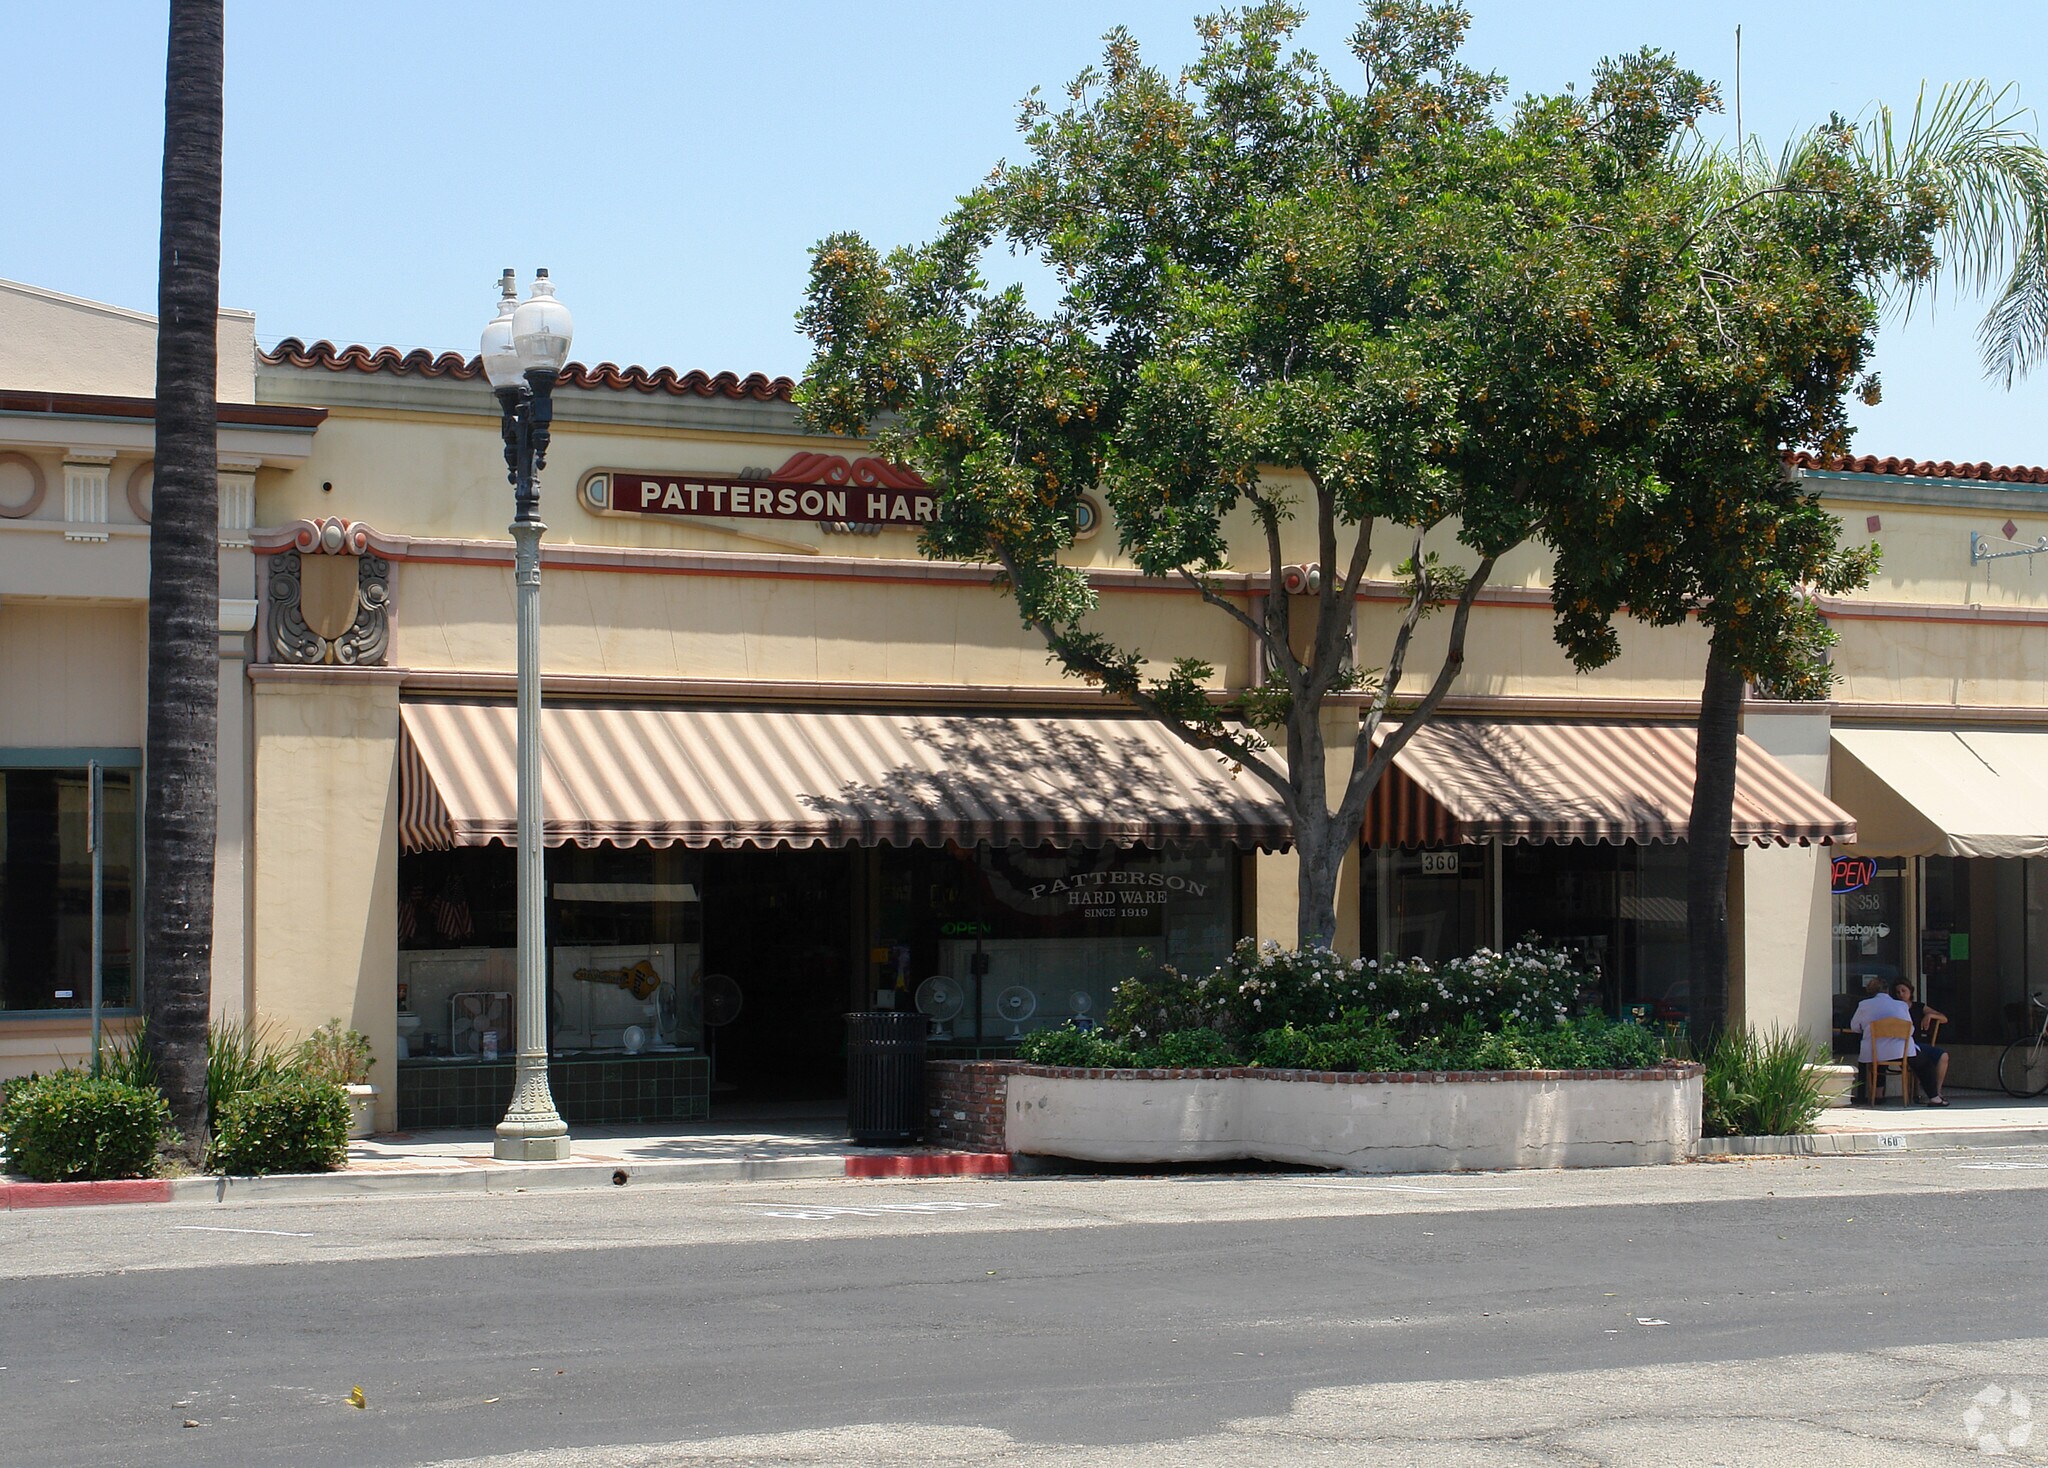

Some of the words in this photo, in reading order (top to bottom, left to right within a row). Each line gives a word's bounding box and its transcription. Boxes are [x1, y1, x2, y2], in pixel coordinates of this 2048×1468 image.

[640, 481, 847, 517] PATTERSON
[1425, 855, 1457, 871] 360
[1028, 871, 1208, 900] PATTERSON
[1068, 890, 1115, 905] HARD
[1119, 890, 1168, 904] WARE
[1859, 894, 1880, 911] 358
[1084, 908, 1116, 918] SINCE
[1120, 908, 1149, 918] 1919
[945, 921, 992, 935] OPEN
